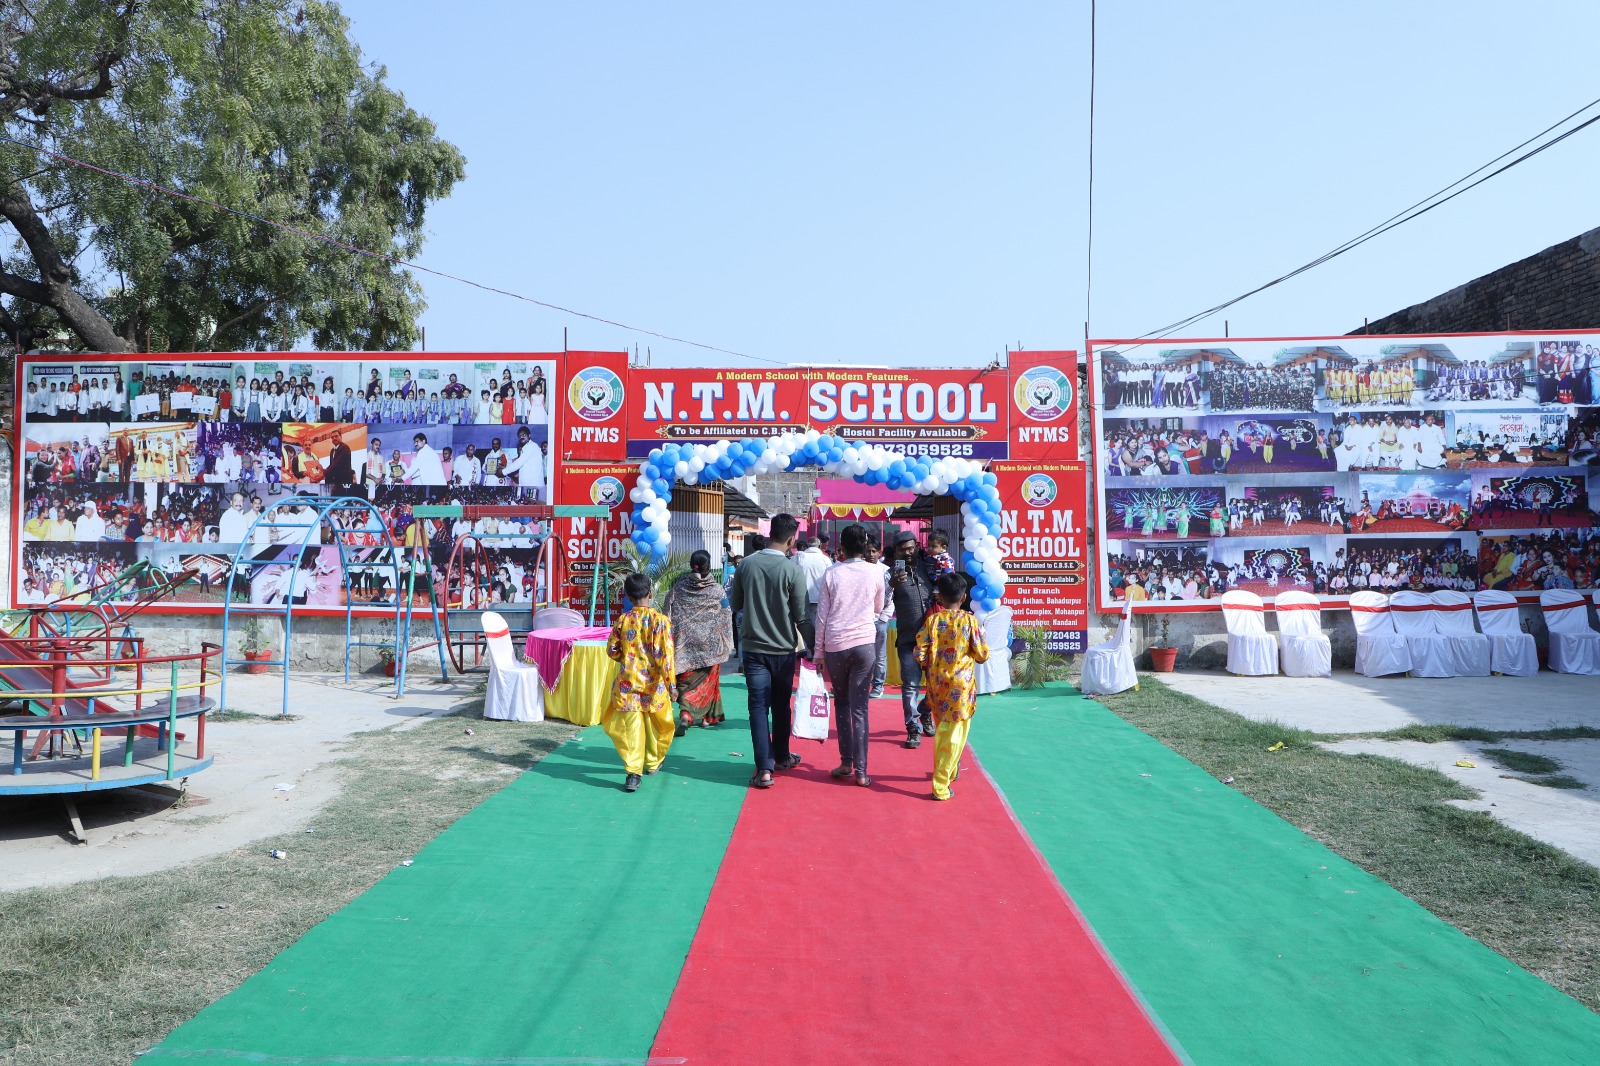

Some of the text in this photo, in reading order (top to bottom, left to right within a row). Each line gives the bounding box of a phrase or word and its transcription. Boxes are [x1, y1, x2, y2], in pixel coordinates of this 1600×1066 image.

[716, 372, 724, 380] A
[725, 372, 762, 380] Modern
[765, 372, 799, 380] School
[802, 372, 823, 380] with
[826, 372, 863, 381] Modern
[643, 382, 790, 421] N.T.M.
[809, 381, 998, 423] SCHOOL
[570, 426, 620, 443] NTMS
[674, 427, 686, 435] To
[689, 427, 700, 435] be
[703, 427, 747, 435] Affiliated
[749, 427, 758, 435] to
[843, 428, 967, 438] Hostel Facility Available
[1018, 426, 1070, 443] NTMS
[866, 443, 974, 456] 73059525
[1001, 509, 1081, 534] N.T.M.
[999, 536, 1081, 558] SCHOOL
[1025, 576, 1046, 584] Facility
[1003, 597, 1021, 605] Durga
[1046, 597, 1082, 606] Bahadurpur
[1054, 608, 1084, 616] Mohanpur
[1052, 618, 1077, 626] Nandani
